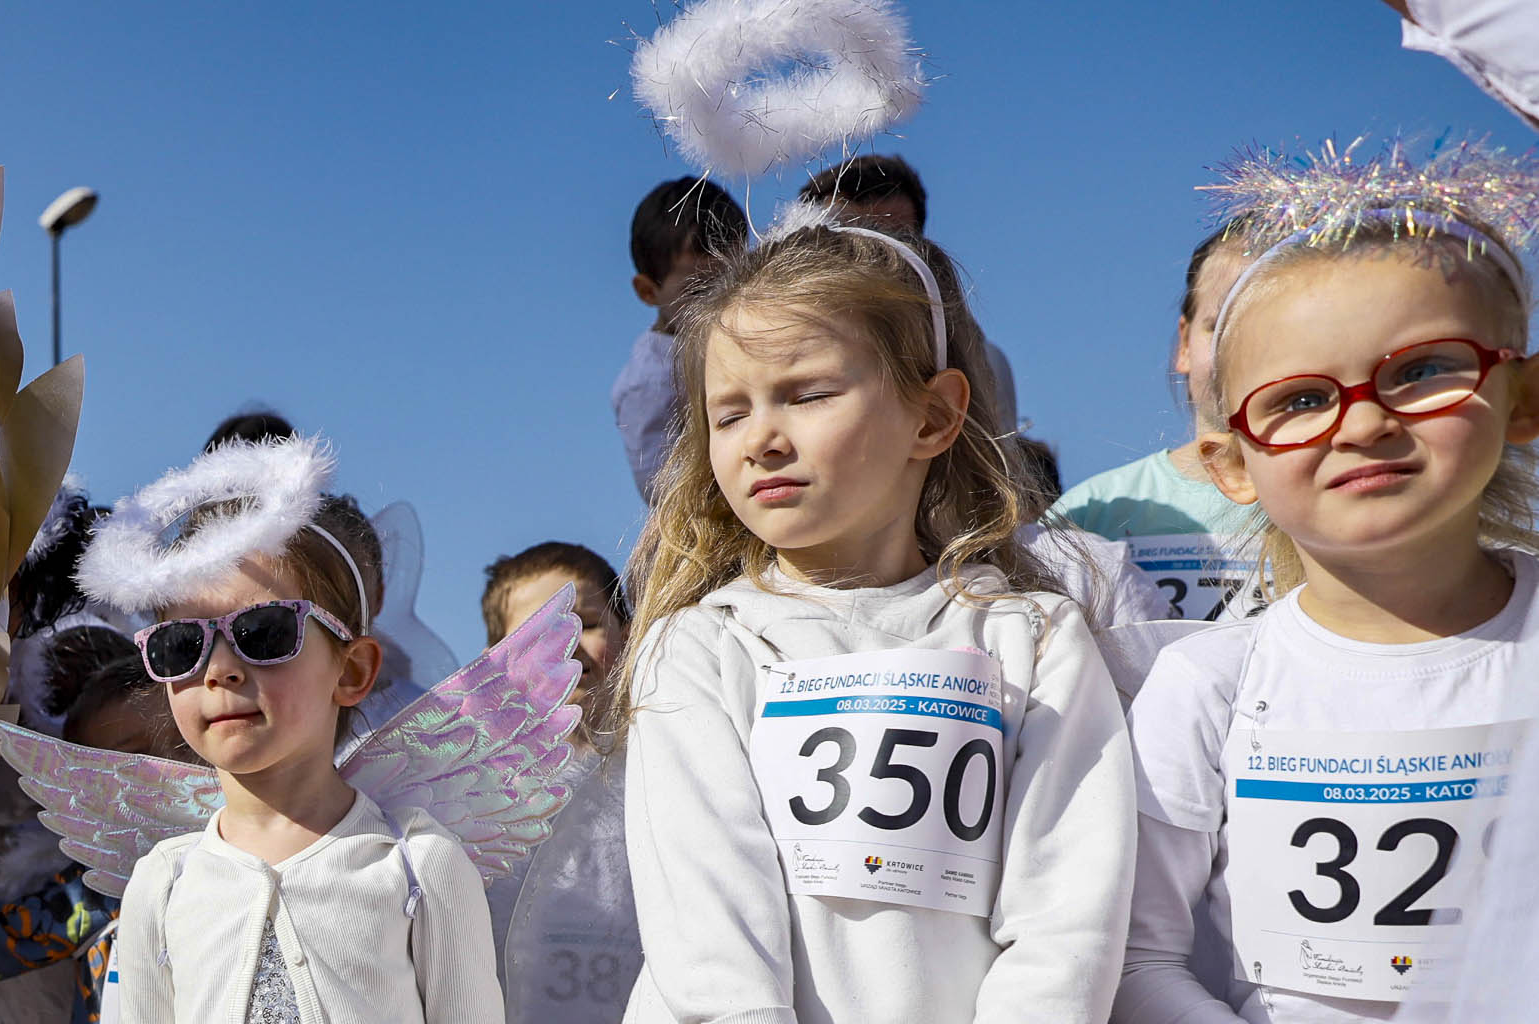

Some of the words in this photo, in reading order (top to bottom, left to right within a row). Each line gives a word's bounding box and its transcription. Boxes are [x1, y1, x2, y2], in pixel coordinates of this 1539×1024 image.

[797, 679, 822, 692] BIEG
[824, 673, 880, 690] FUNDACJI
[883, 672, 940, 690] ŚLĄSKIE
[942, 676, 989, 696] ANIOŁY
[836, 699, 907, 711] 08.03.2025
[917, 701, 989, 721] KATOWICE
[1247, 756, 1265, 770] 12.
[1267, 756, 1297, 771] BIEG
[1300, 757, 1373, 774] FUNDACJI
[1376, 755, 1447, 776] ŚLĄSKIE
[789, 727, 997, 841] 350
[1323, 786, 1411, 801] 08.03.2025
[1287, 817, 1500, 927] 32
